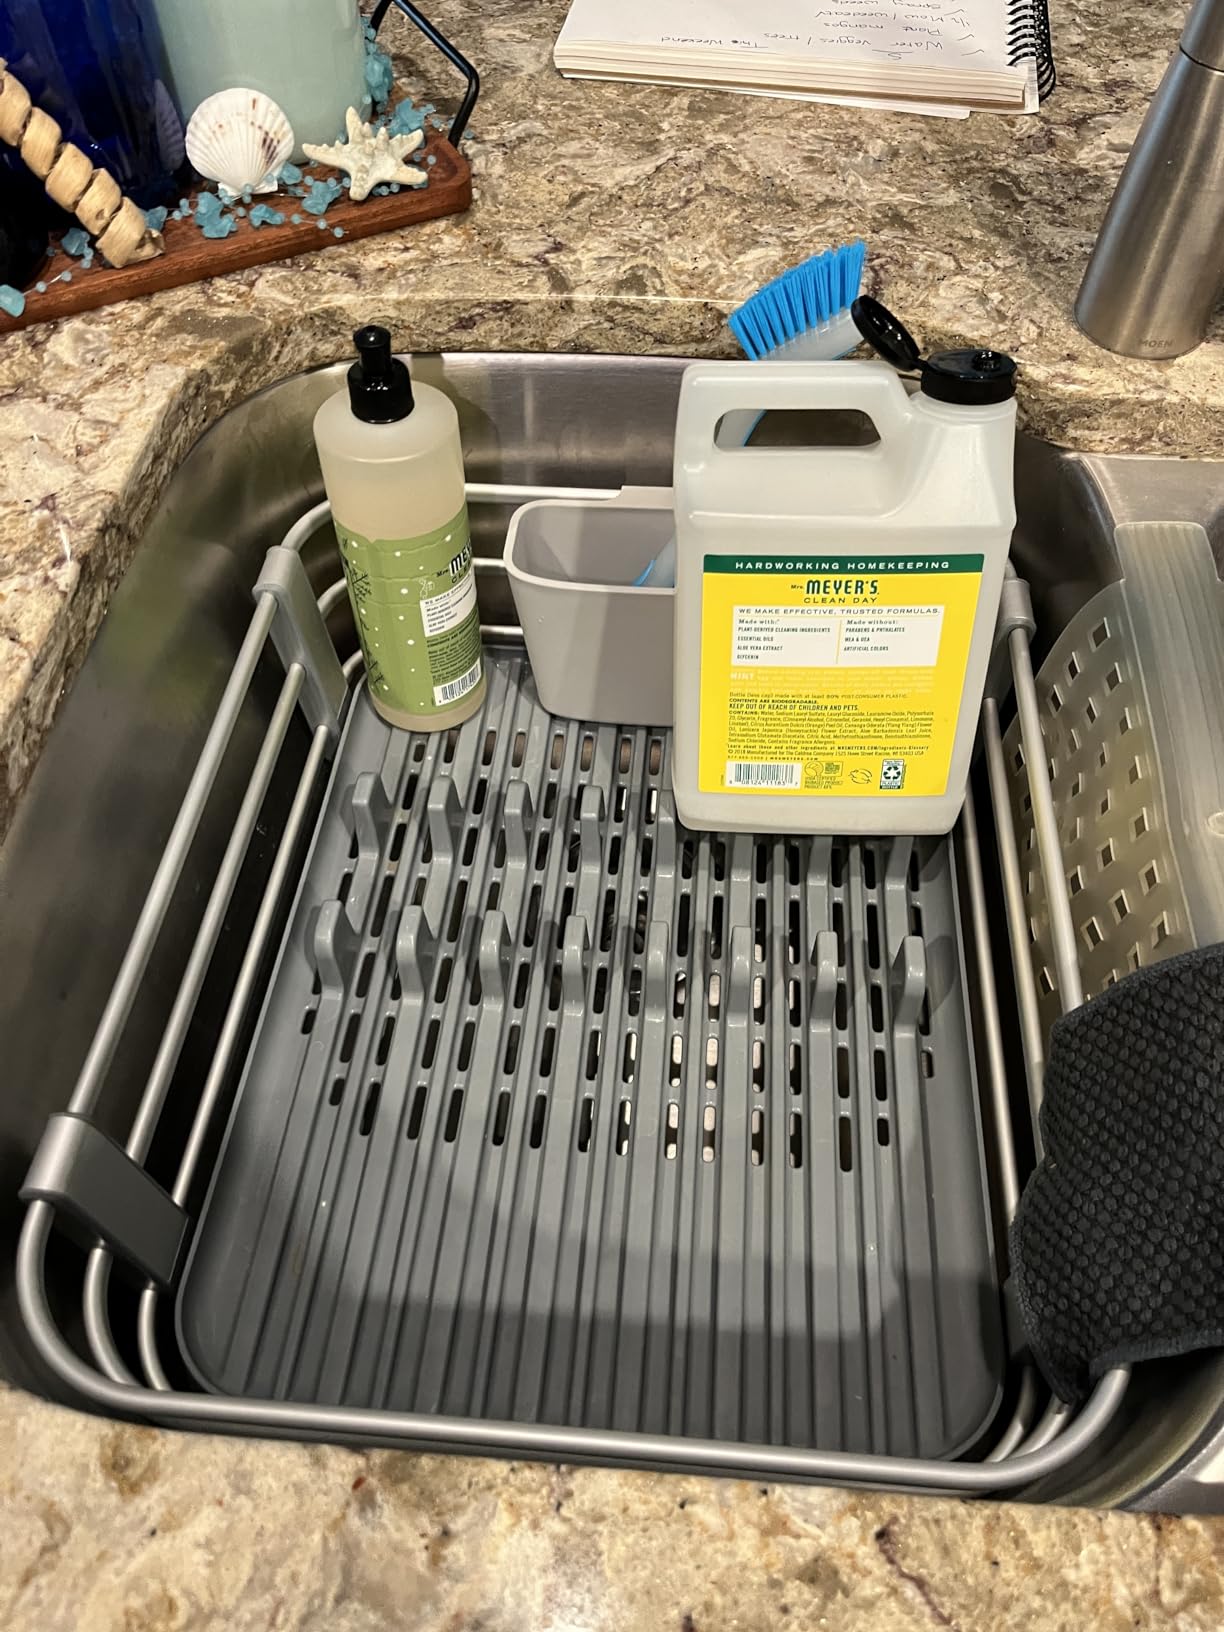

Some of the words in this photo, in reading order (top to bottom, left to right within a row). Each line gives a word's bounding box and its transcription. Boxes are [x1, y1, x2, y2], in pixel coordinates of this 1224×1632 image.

[904, 14, 945, 23] Mow
[824, 21, 884, 30] mangos
[902, 26, 944, 36] Plant
[820, 36, 872, 46] veggies
[890, 40, 943, 50] Water
[1138, 339, 1174, 348] MOEN
[735, 562, 840, 570] HARDWORKING
[848, 562, 950, 570] HOMEKEEPING
[806, 580, 879, 594] MEYER'S
